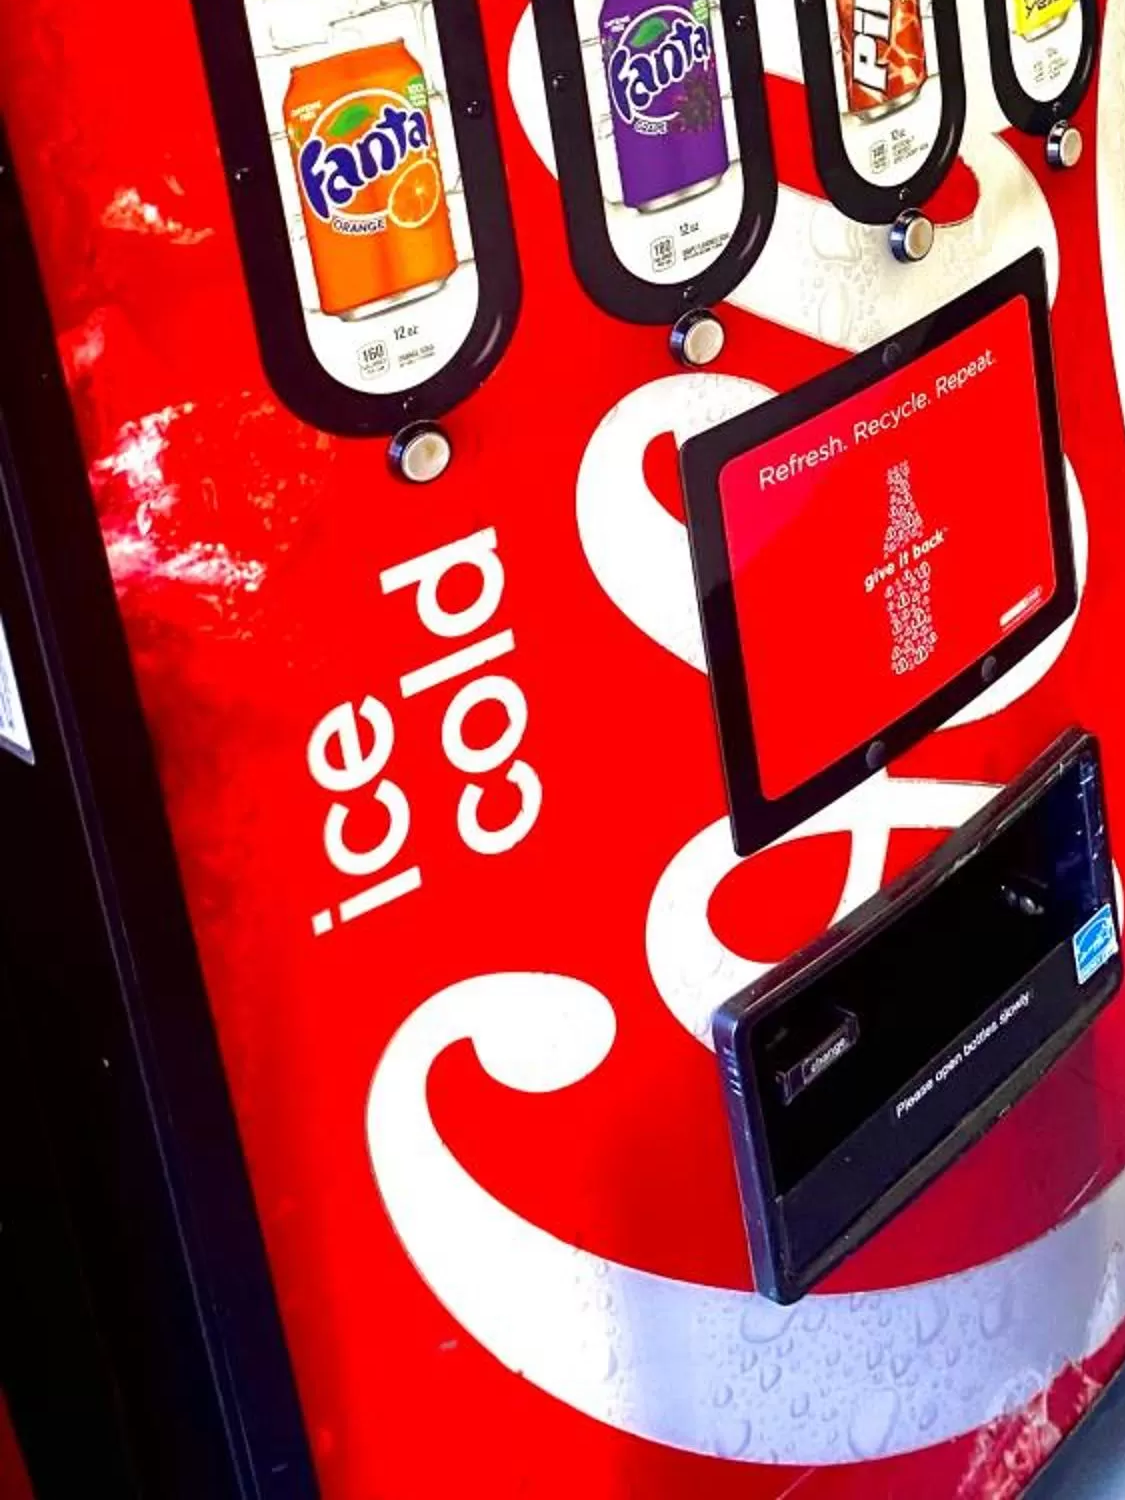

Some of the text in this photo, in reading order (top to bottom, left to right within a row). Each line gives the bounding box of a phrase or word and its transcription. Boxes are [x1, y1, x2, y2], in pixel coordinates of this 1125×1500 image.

[609, 17, 711, 124] Fanta
[299, 104, 431, 222] Fanta
[333, 215, 386, 233] ORANGE
[363, 343, 385, 363] 160
[759, 436, 849, 491] Refresh.
[853, 393, 932, 444] Recycle.
[865, 529, 945, 592] give it back
[379, 526, 543, 855] cold
[307, 694, 422, 937] ice
[896, 990, 1030, 1119] Please open bottles slowly
